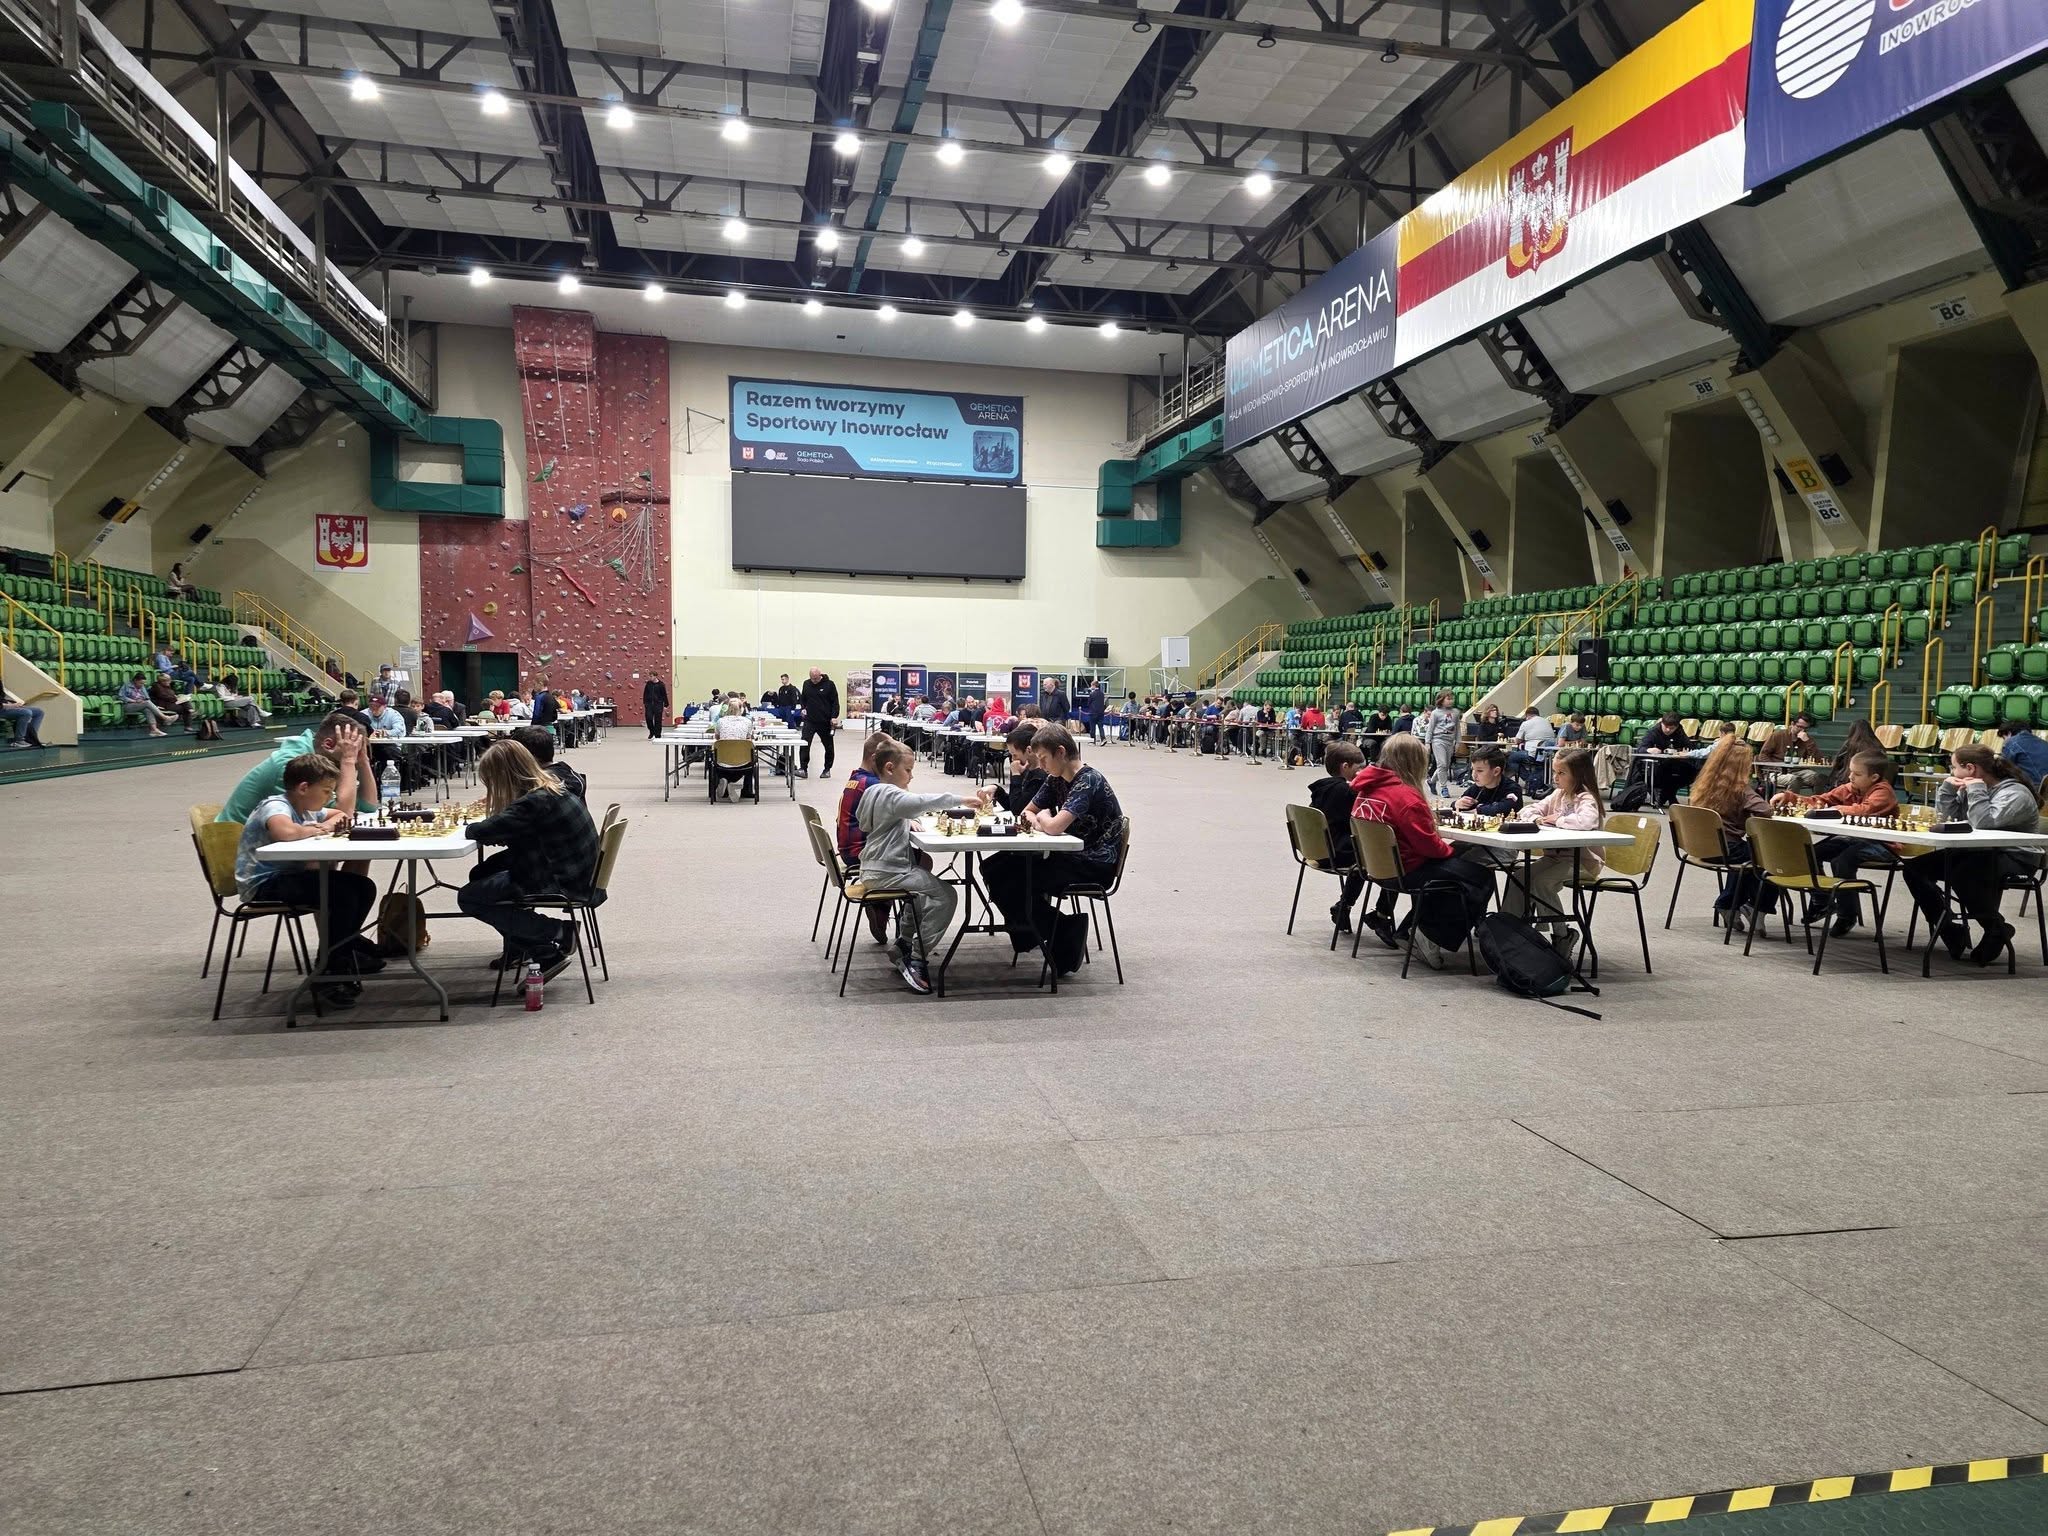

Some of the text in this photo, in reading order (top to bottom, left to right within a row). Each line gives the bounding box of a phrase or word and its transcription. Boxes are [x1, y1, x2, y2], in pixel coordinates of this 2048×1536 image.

[1315, 268, 1392, 346] ARENA
[1940, 303, 1966, 321] BC
[1242, 365, 1319, 413] WIDOWISKOWO-SPORTOWA
[1328, 325, 1389, 368] INOWROCŁAWIU
[1695, 381, 1714, 395] BB
[746, 390, 906, 420] Razem tworzymy
[969, 402, 1018, 415] QEMETICA
[977, 411, 1010, 422] ARENA
[746, 412, 949, 441] Sportowy Inowrocław
[1532, 435, 1545, 446] BA
[796, 450, 834, 459] QEMETICA
[1795, 470, 1818, 488] B
[1818, 507, 1841, 520] BC
[1615, 542, 1631, 552] BB
[1478, 565, 1492, 574] BA
